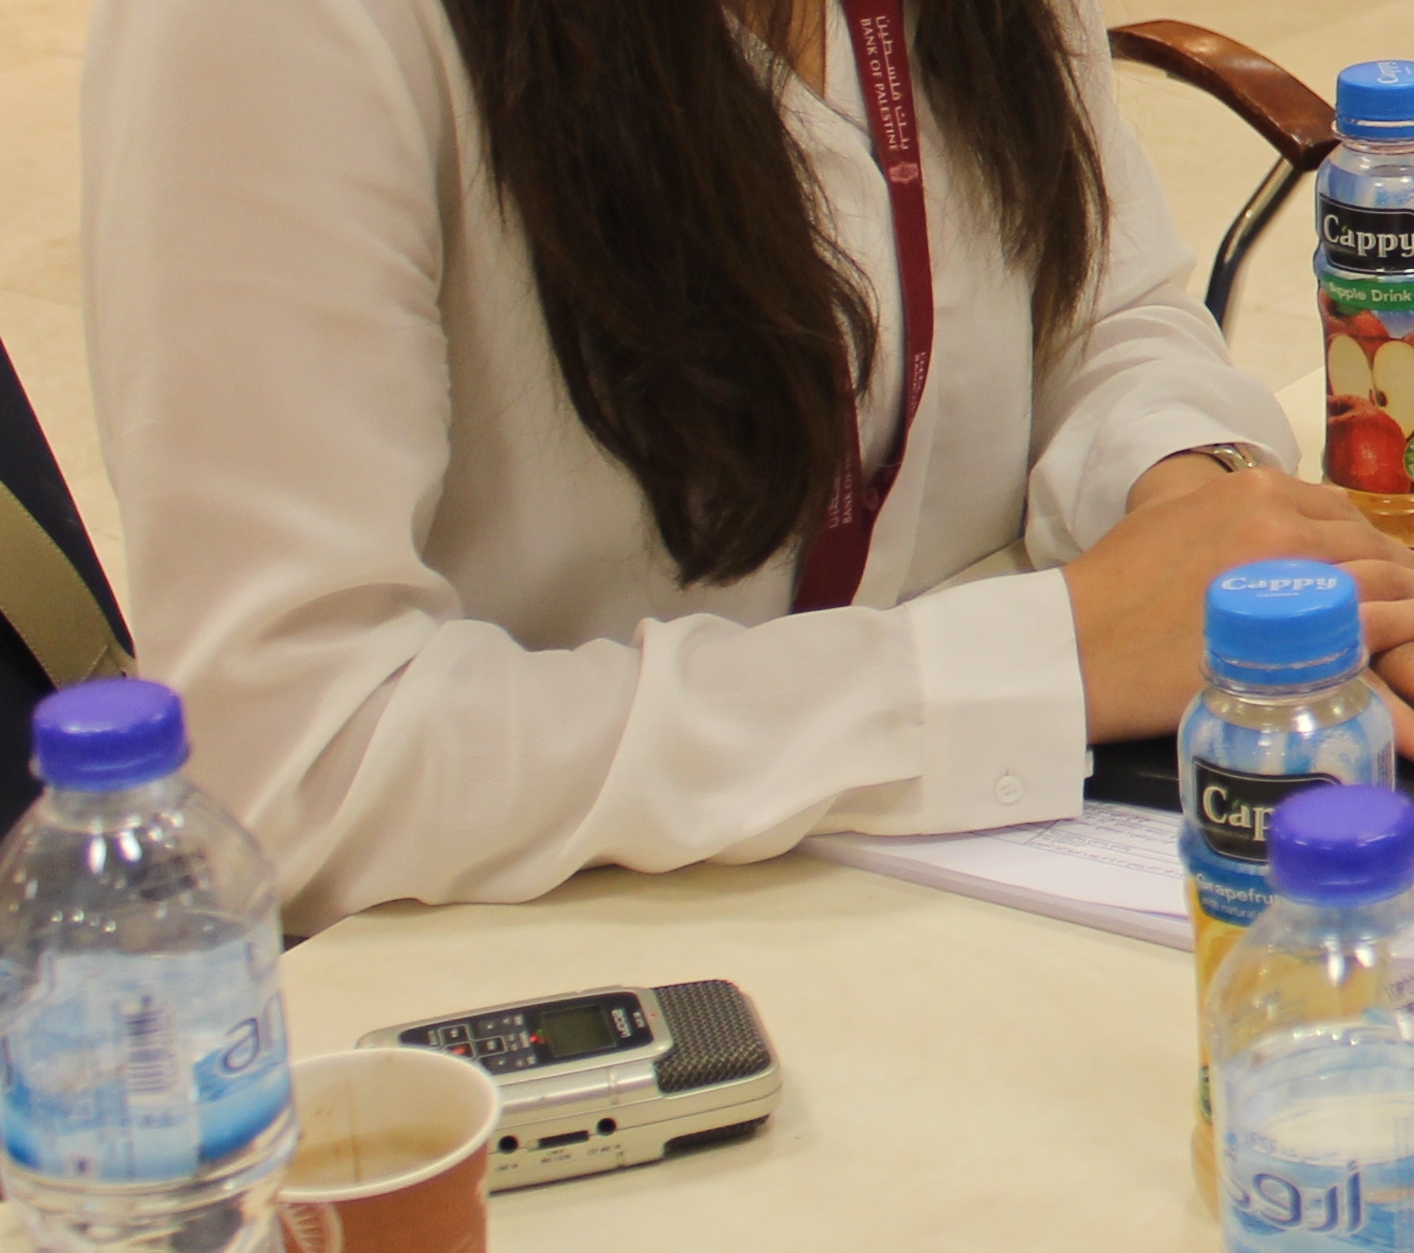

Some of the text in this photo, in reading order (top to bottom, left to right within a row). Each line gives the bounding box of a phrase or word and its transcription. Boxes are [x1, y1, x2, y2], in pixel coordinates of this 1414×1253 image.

[860, 18, 898, 151] BANK OF PALESTINE
[1371, 287, 1412, 303] Drink
[1221, 577, 1337, 592] Cappy
[1202, 785, 1275, 842] Cap
